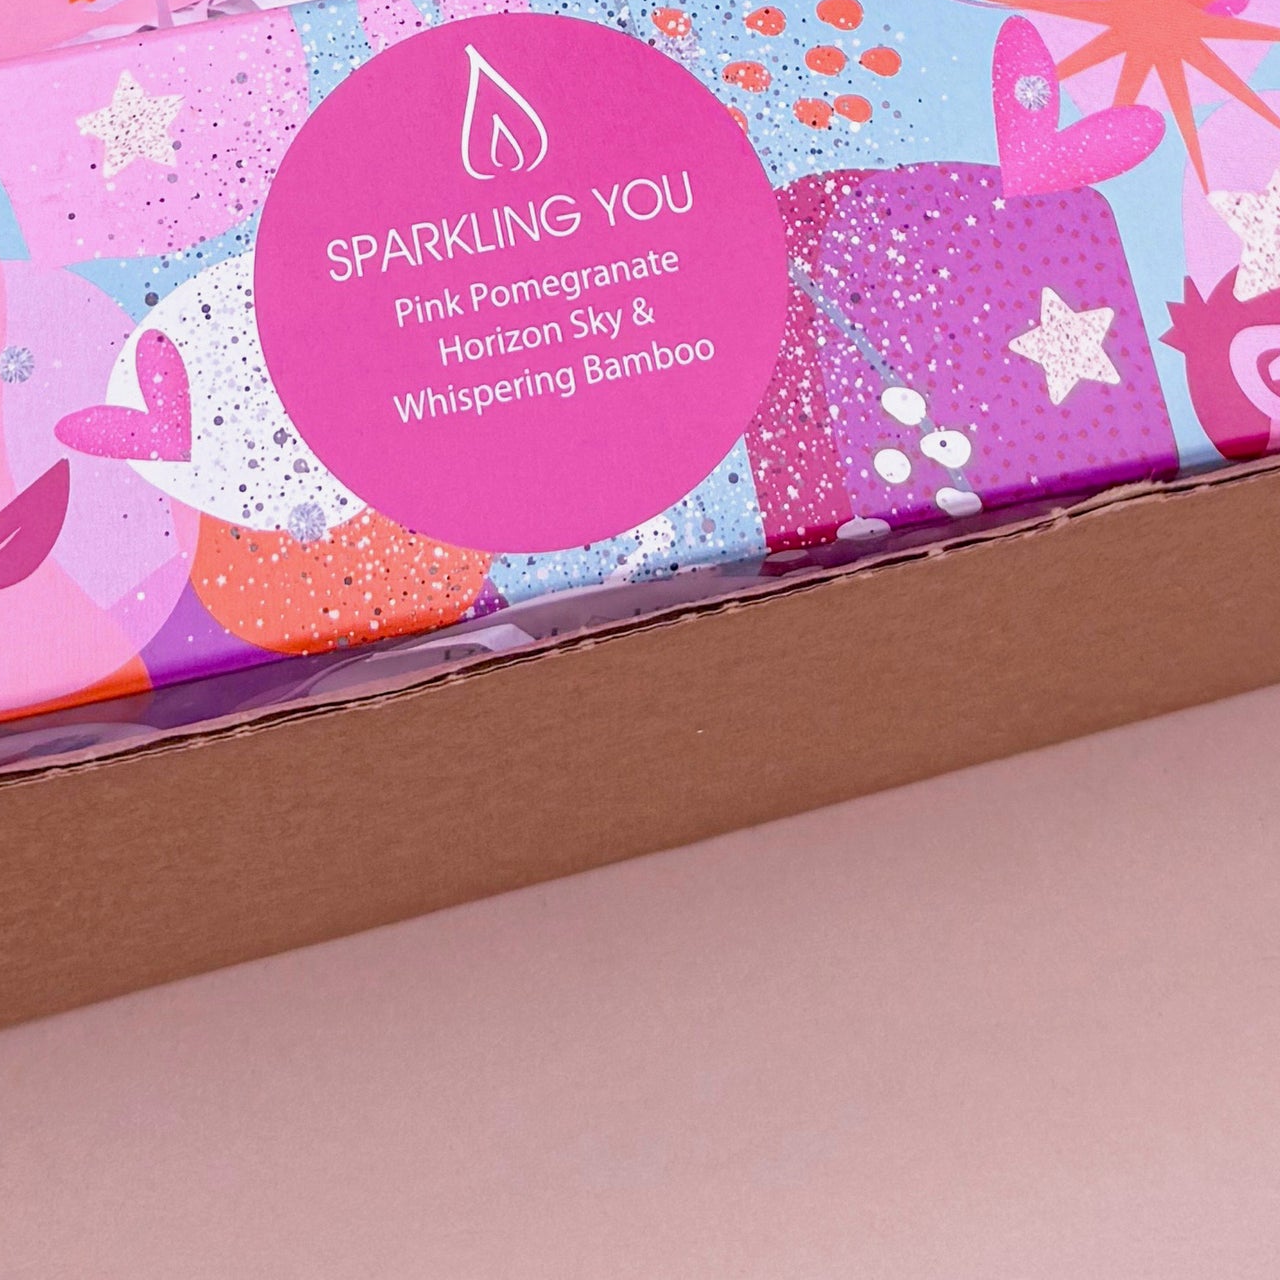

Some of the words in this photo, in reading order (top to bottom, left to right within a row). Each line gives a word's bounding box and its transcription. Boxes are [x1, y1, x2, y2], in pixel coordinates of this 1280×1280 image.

[326, 194, 582, 282] SPARKLING
[591, 170, 694, 227] YOU
[394, 288, 464, 328] Pink
[471, 250, 679, 310] Pomegranate
[438, 320, 563, 366] Horizon
[570, 303, 624, 341] Sky
[632, 296, 655, 325] &
[393, 366, 577, 423] Whispering
[584, 337, 716, 385] Bamboo
